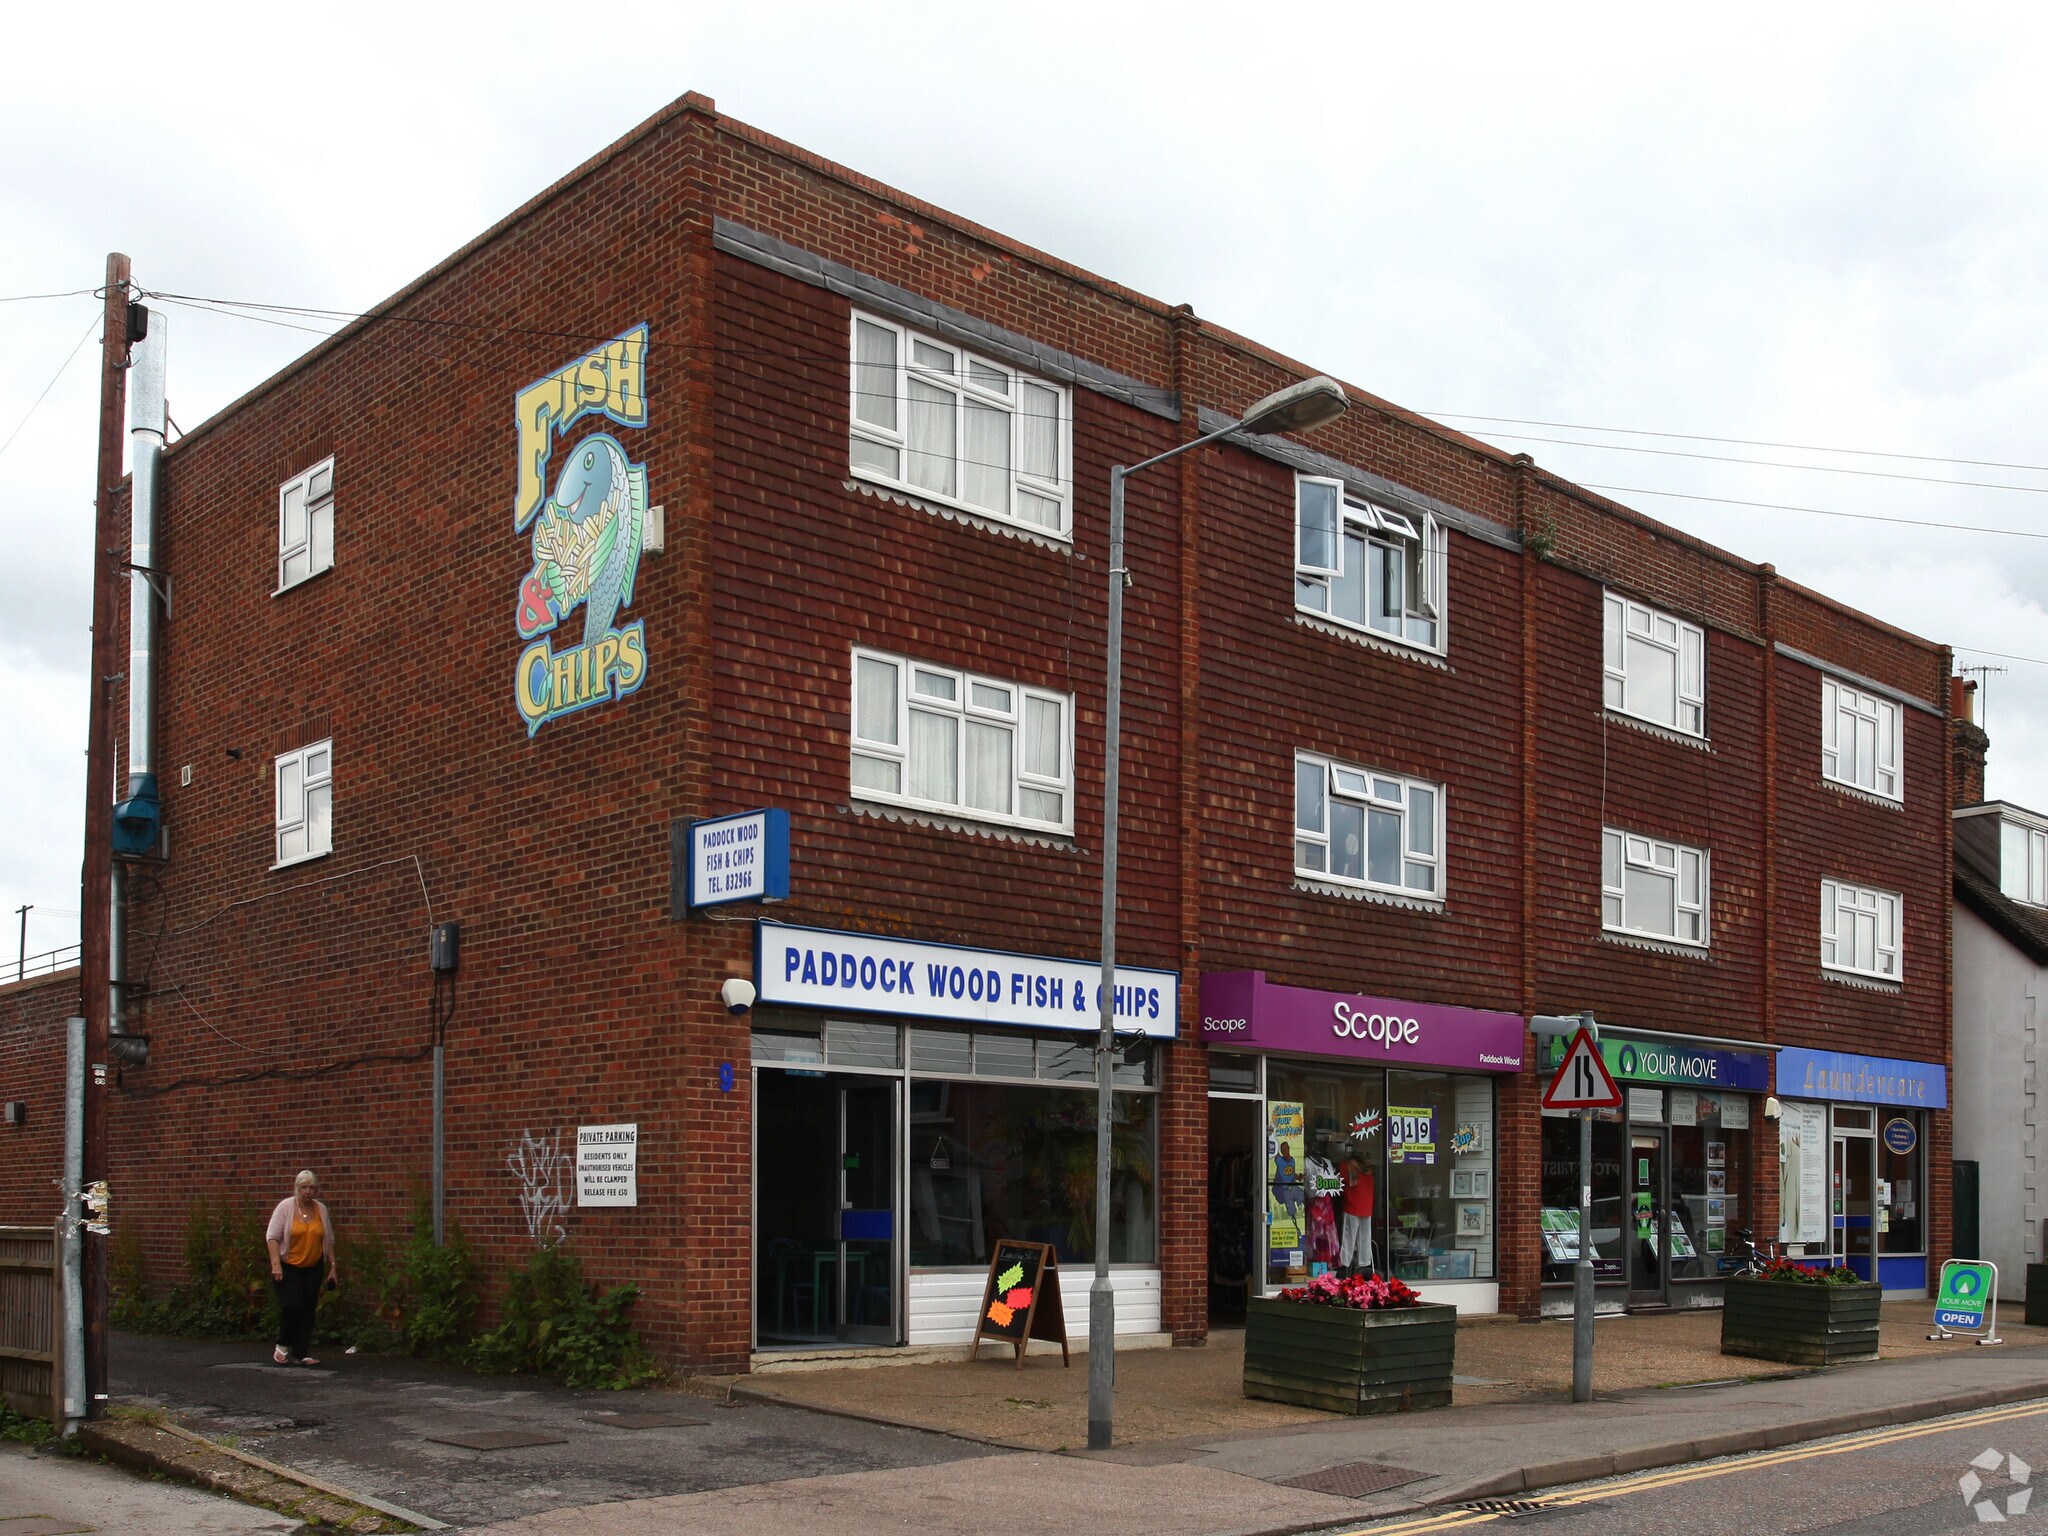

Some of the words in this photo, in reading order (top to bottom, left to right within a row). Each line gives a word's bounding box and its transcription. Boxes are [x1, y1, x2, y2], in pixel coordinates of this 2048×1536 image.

[516, 328, 645, 525] FISH
[518, 578, 554, 633] &
[518, 630, 643, 717] CHIPS
[703, 827, 735, 850] PADDOCK
[737, 823, 758, 841] WOOD
[706, 854, 722, 872] FISH
[724, 852, 731, 868] &
[733, 847, 754, 866] CHIPS
[708, 876, 722, 894] TEL.
[725, 870, 752, 891] 832966
[785, 947, 915, 995] PADDOCK
[928, 963, 1001, 1003] WOOD
[1011, 973, 1063, 1010] FISH
[1073, 980, 1086, 1013] &
[1204, 1016, 1246, 1033] Scope
[1333, 1001, 1420, 1049] Scope
[1479, 1053, 1503, 1065] Paddock
[1504, 1056, 1520, 1067] Wood
[1639, 1052, 1676, 1075] YOUR
[1680, 1057, 1717, 1079] MOVE
[1803, 1061, 1926, 1098] Laundercare
[579, 1132, 603, 1143] PRIVATE
[605, 1131, 635, 1142] PARKING
[578, 1164, 611, 1172] UNAUTHORISED
[612, 1164, 633, 1172] VEHICLES
[584, 1188, 605, 1196] RELEASE
[607, 1188, 617, 1196] FEE
[1942, 1313, 1974, 1324] OPEN
